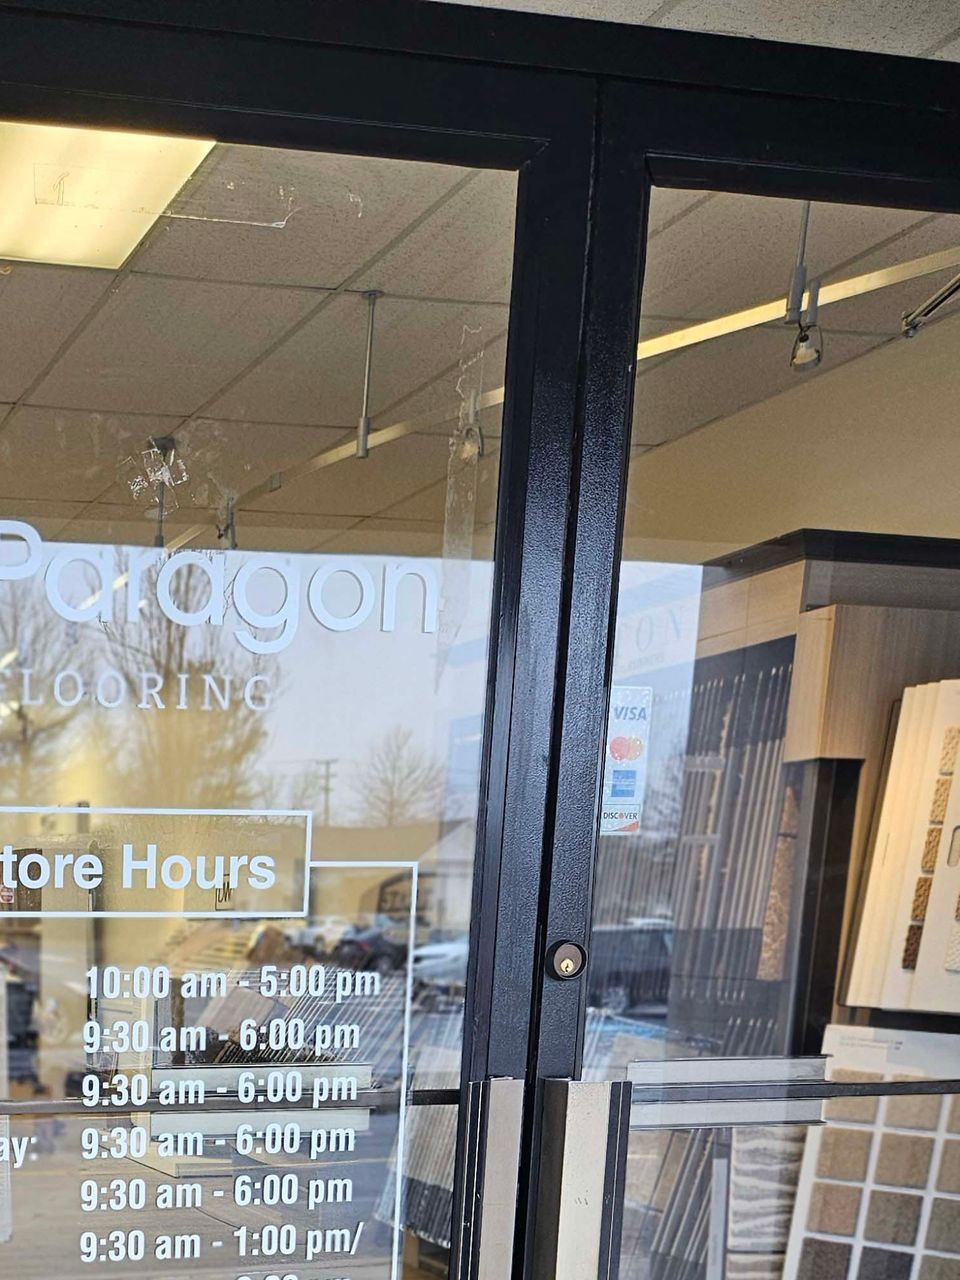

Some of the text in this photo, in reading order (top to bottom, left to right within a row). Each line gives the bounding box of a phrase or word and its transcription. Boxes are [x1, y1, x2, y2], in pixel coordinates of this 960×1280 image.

[614, 706, 647, 720] VISA
[603, 812, 638, 820] DISCOVER
[122, 843, 276, 890] Hours
[84, 966, 171, 1000] 10:00
[180, 973, 228, 998] am
[259, 964, 326, 998] 5:00
[336, 970, 381, 1003] pm
[82, 1020, 150, 1054] 9:30
[159, 1028, 207, 1053] am
[238, 1018, 306, 1050] 6:00
[314, 1022, 361, 1056] pm
[81, 1073, 149, 1107] 9:30
[158, 1081, 206, 1106] am
[237, 1071, 304, 1103] 6:00
[312, 1075, 358, 1110] pm
[80, 1127, 148, 1161] 9:30
[157, 1133, 204, 1158] am
[235, 1123, 302, 1155] 6:00
[310, 1128, 356, 1161] pm
[80, 1179, 147, 1212] 9:30
[156, 1185, 203, 1210] am
[234, 1174, 299, 1206] 6:00
[306, 1180, 353, 1213] pm
[79, 1230, 145, 1263] 9:30
[155, 1236, 201, 1261] am
[233, 1226, 297, 1257] 1:00
[305, 1222, 366, 1263] pm/
